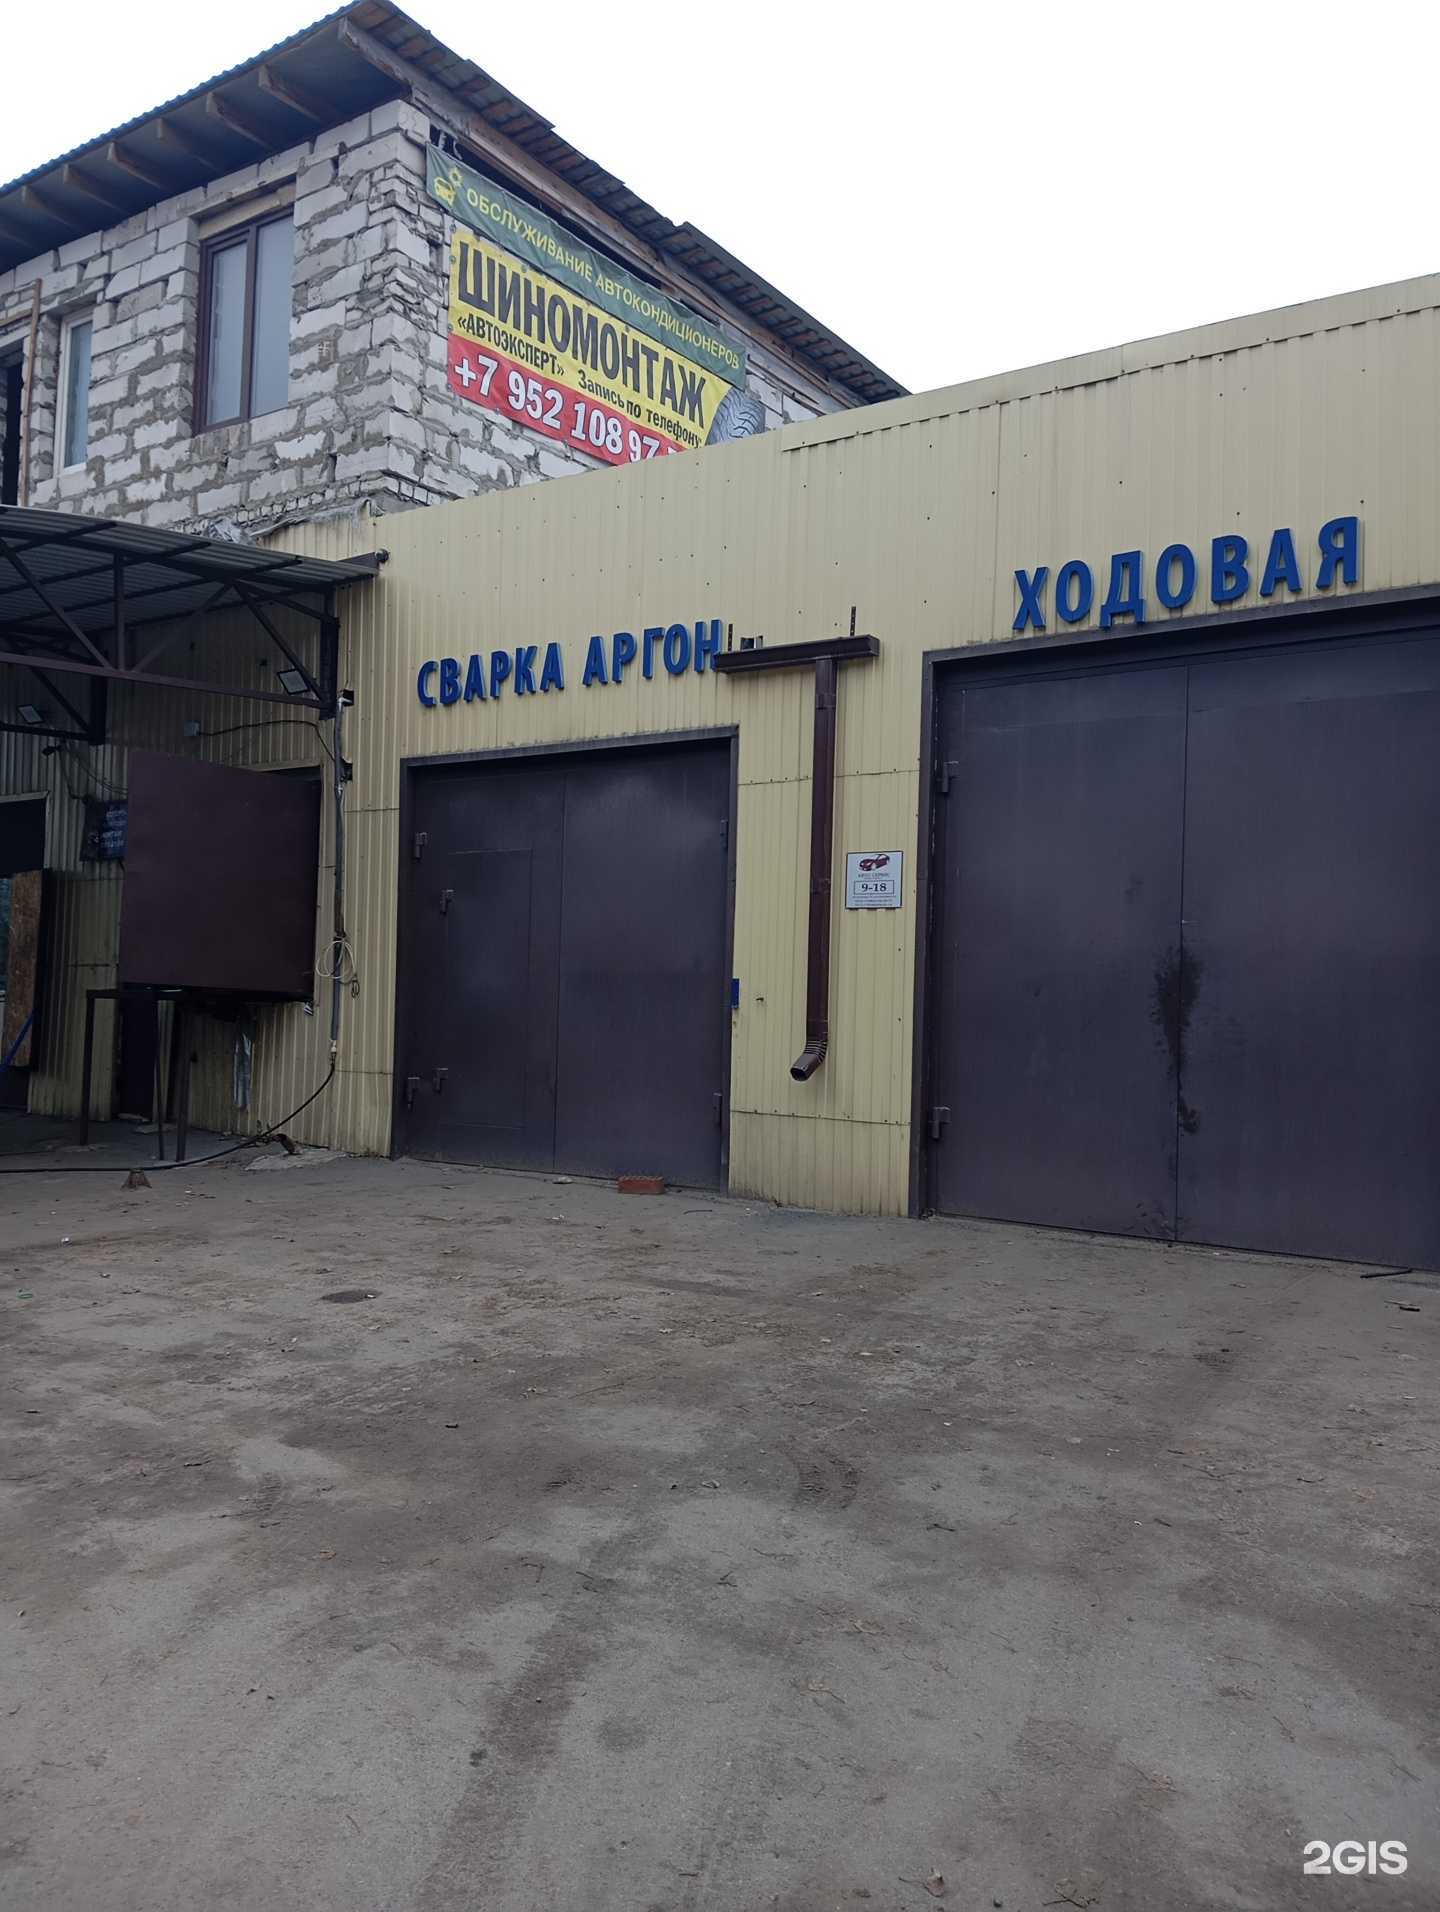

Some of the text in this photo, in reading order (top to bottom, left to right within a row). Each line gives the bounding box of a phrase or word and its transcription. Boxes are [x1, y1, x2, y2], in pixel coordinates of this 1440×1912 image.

[457, 242, 706, 429] ШИНОМОНТАЖ
[466, 187, 740, 370] ОБСЛУЖИВАНИЕ АВТОКОНДИЦИОНЕРОВ
[454, 353, 498, 397] +7
[508, 370, 563, 430] 952
[571, 402, 623, 454] 108
[457, 313, 702, 449] «АВТОЭКСПЕРТ» Запись по телефону
[1012, 516, 1359, 630] ХОДОВАЯ
[417, 619, 722, 707] СВАРКА АРГОН
[861, 883, 887, 892] 9-18
